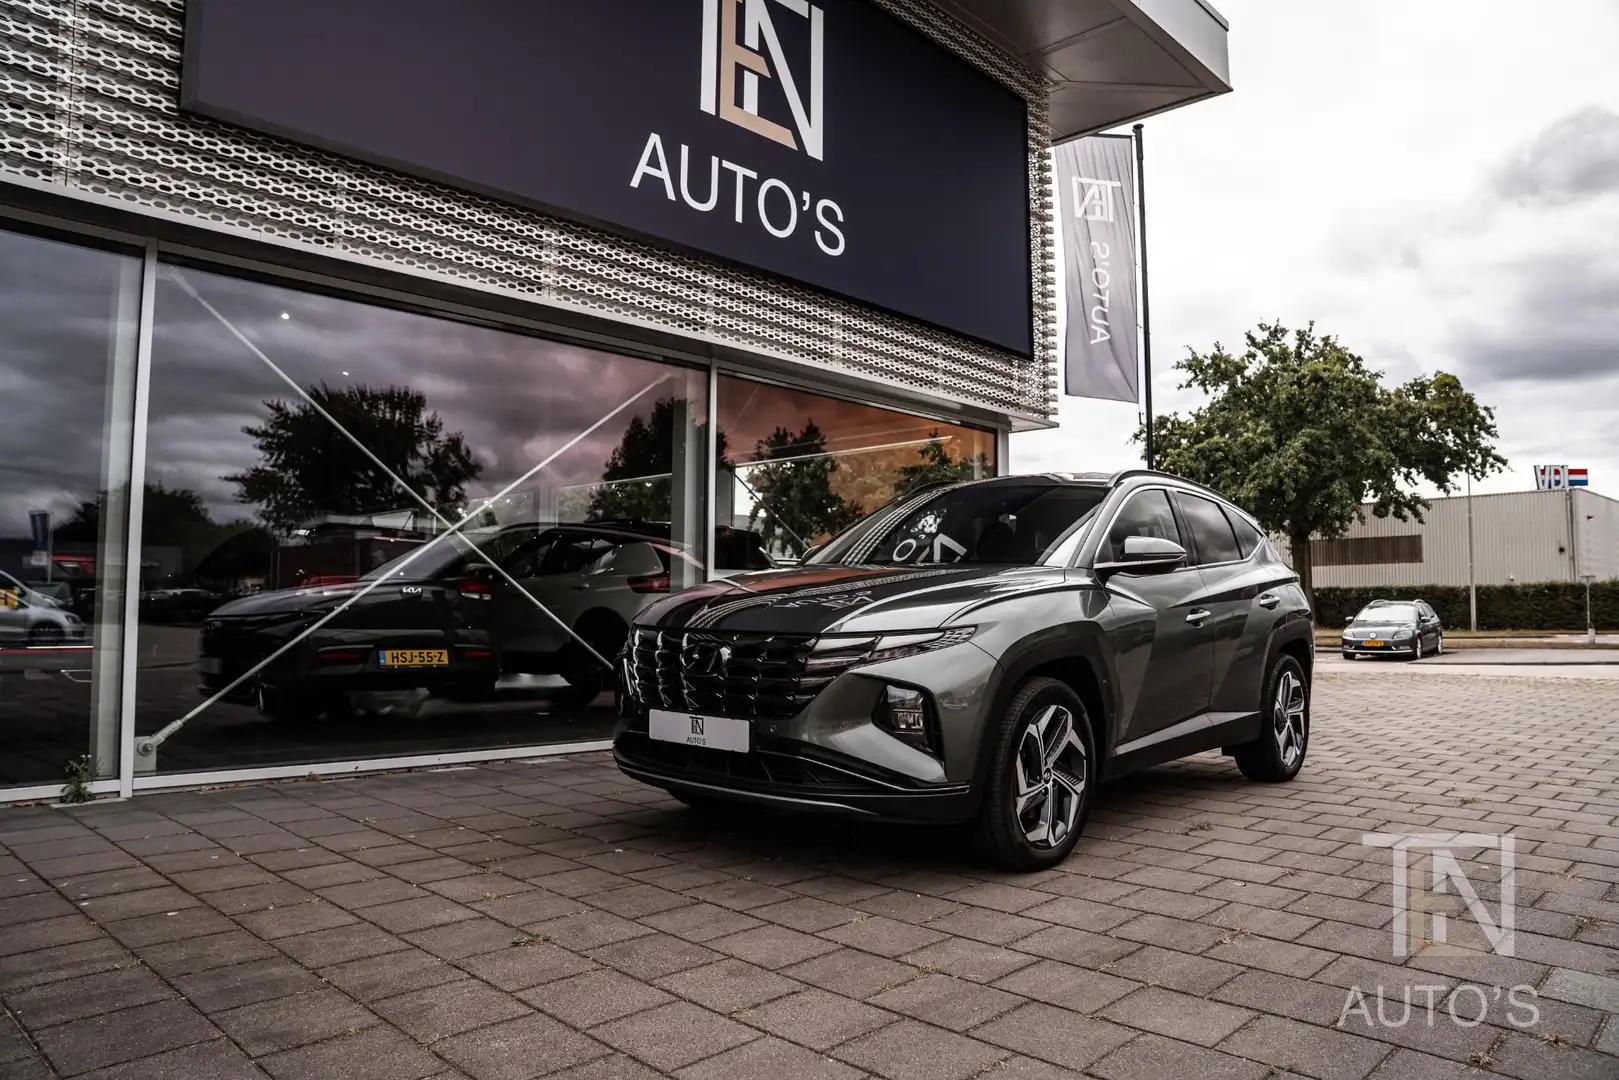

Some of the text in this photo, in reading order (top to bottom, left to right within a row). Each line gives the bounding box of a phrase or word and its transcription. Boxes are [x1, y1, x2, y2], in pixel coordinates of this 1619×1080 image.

[629, 132, 845, 257] AUTO'S
[391, 651, 444, 663] HSJ-55-Z
[687, 736, 706, 745] AUTO'S
